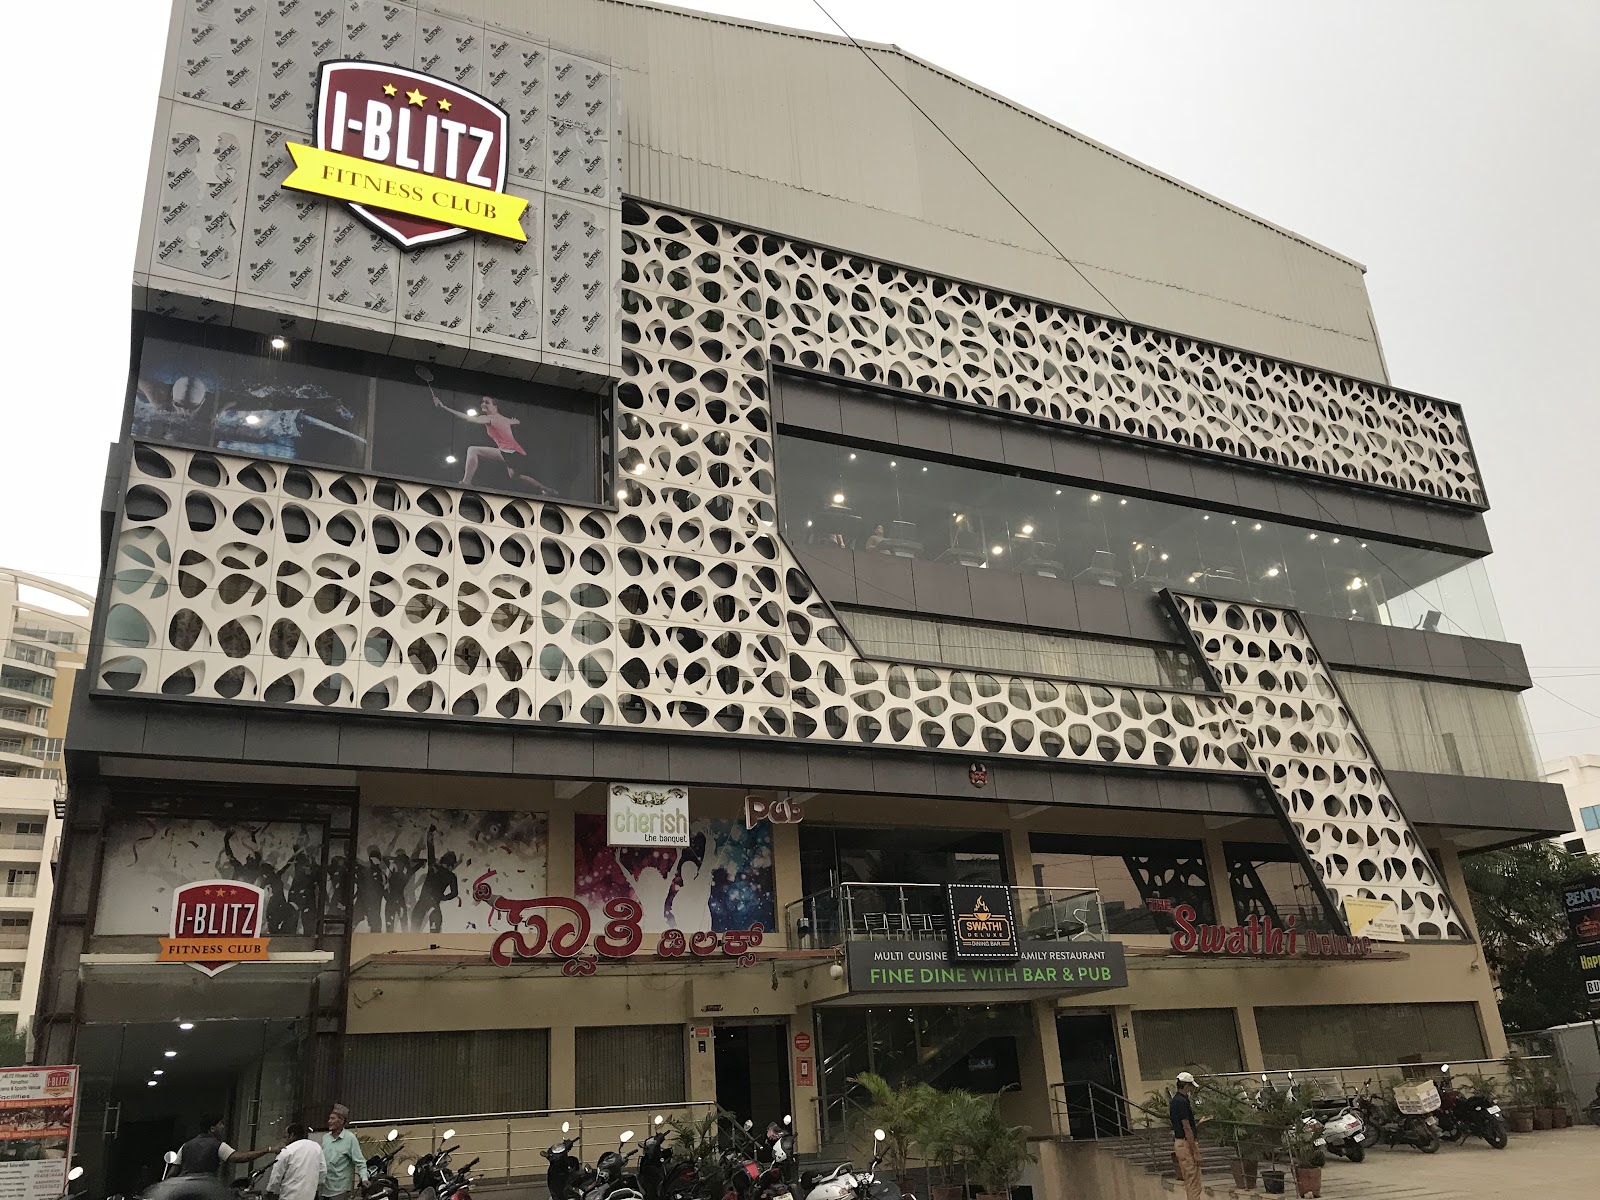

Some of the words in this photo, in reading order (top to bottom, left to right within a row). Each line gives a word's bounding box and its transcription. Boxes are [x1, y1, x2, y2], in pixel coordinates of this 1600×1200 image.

[235, 5, 256, 24] ALSTONE
[316, 8, 335, 27] ALSTONE
[193, 25, 214, 45] ALSTONE
[276, 28, 297, 47] ALSTONE
[348, 22, 367, 40] ALSTONE
[424, 26, 442, 44] ALSTONE
[232, 36, 253, 55] ALSTONE
[314, 38, 334, 57] ALSTONE
[383, 32, 402, 50] ALSTONE
[458, 35, 475, 53] ALSTONE
[492, 41, 509, 59] ALSTONE
[188, 56, 210, 76] ALSTONE
[273, 59, 294, 78] ALSTONE
[423, 54, 441, 72] ALSTONE
[524, 51, 540, 68] ALSTONE
[228, 67, 249, 86] ALSTONE
[456, 63, 474, 81] ALSTONE
[490, 69, 508, 87] ALSTONE
[557, 64, 572, 80] ALSTONE
[587, 72, 602, 89] ALSTONE
[523, 78, 539, 96] ALSTONE
[270, 90, 290, 110] ALSTONE
[556, 91, 572, 108] ALSTONE
[587, 100, 602, 117] ALSTONE
[522, 106, 538, 124] ALSTONE
[173, 134, 196, 155] ALSTONE
[331, 90, 494, 187] I-BLITZ
[217, 144, 237, 162] LSTONE
[554, 147, 571, 165] ALSTONE
[263, 158, 284, 178] ALSTONE
[586, 156, 601, 173] ALSTONE
[168, 168, 192, 189] ALSTONE
[210, 177, 233, 198] ALSTONE
[259, 191, 281, 212] ALSTONE
[321, 165, 423, 201] FITNESS
[432, 192, 496, 219] CLUB
[164, 202, 188, 224] ALSTONE
[298, 200, 319, 220] ALSTONE
[554, 210, 570, 229] ALSTONE
[206, 211, 229, 233] ALSTONE
[255, 224, 277, 246] ALSTONE
[335, 223, 355, 243] ALSTONE
[159, 236, 183, 260] ALSTONE
[294, 233, 316, 254] ALSTONE
[553, 241, 570, 261] ALSTONE
[201, 246, 224, 268] ALSTONE
[332, 256, 352, 277] ALSTONE
[446, 250, 464, 271] ALSTONE
[481, 257, 497, 275] LSTONE
[585, 249, 601, 269] ALSTONE
[252, 259, 274, 281] ALSTONE
[291, 267, 312, 289] ALSTONE
[369, 263, 388, 285] ALSTONE
[513, 265, 530, 285] ALSTONE
[408, 275, 427, 297] ALSTONE
[553, 273, 569, 293] ALSTONE
[585, 280, 601, 300] ALSTONE
[445, 283, 463, 304] ALSTONE
[479, 290, 495, 308] LSTONE
[512, 297, 529, 318] ALSTONE
[552, 305, 569, 326] ALSTONE
[585, 312, 601, 332] ALSTONE
[614, 808, 688, 834] cherish
[645, 834, 657, 842] the
[660, 834, 687, 844] banquet
[1146, 898, 1171, 912] THE
[179, 903, 255, 934] I-BLITZ
[966, 921, 1002, 932] SWATHI
[1170, 904, 1297, 955] Swathi
[1305, 929, 1372, 955] Deluxe
[169, 945, 223, 954] FITNESS
[228, 945, 261, 953] CLUB
[874, 952, 903, 960] MULTI
[908, 952, 947, 960] CUISINE
[1021, 952, 1047, 960] AMILY
[1049, 952, 1105, 960] RESTAURANT
[870, 968, 914, 984] FINE
[920, 968, 966, 983] DINE
[972, 967, 1017, 982] WITH
[1023, 967, 1059, 982] BAR
[1062, 968, 1074, 982] &
[1079, 966, 1112, 981] PUB
[1588, 982, 1600, 992] BU
[48, 1076, 68, 1086] I-BLITZ
